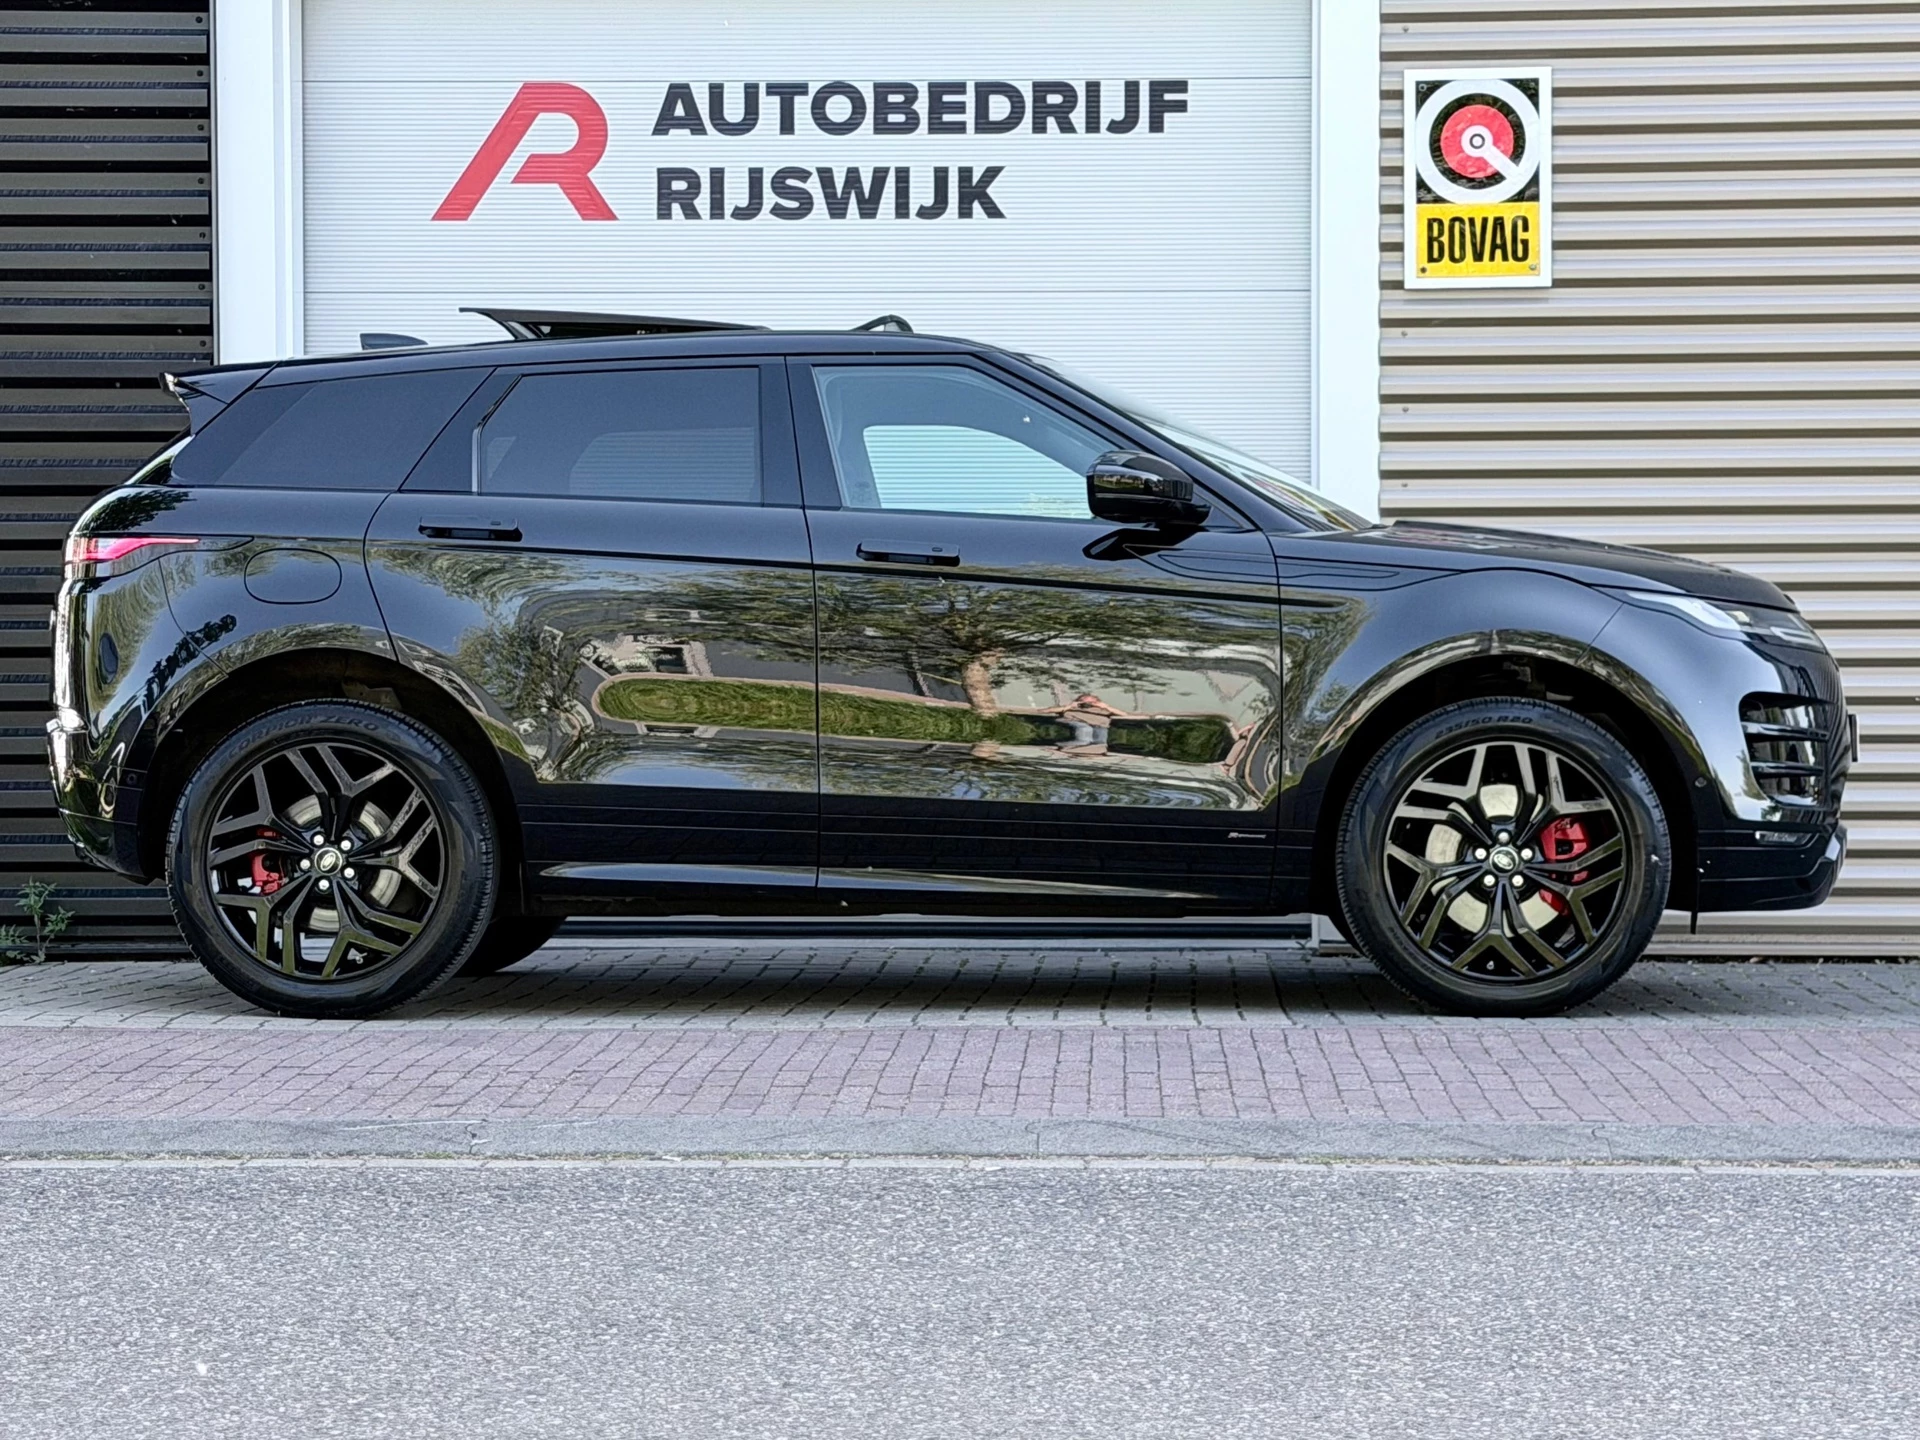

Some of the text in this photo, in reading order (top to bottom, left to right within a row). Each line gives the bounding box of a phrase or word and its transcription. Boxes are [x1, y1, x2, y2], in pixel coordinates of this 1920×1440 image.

[652, 80, 1189, 136] AUTOBEDRIJF
[656, 166, 1006, 221] RIJSWIJK
[1427, 215, 1530, 264] BOVAG
